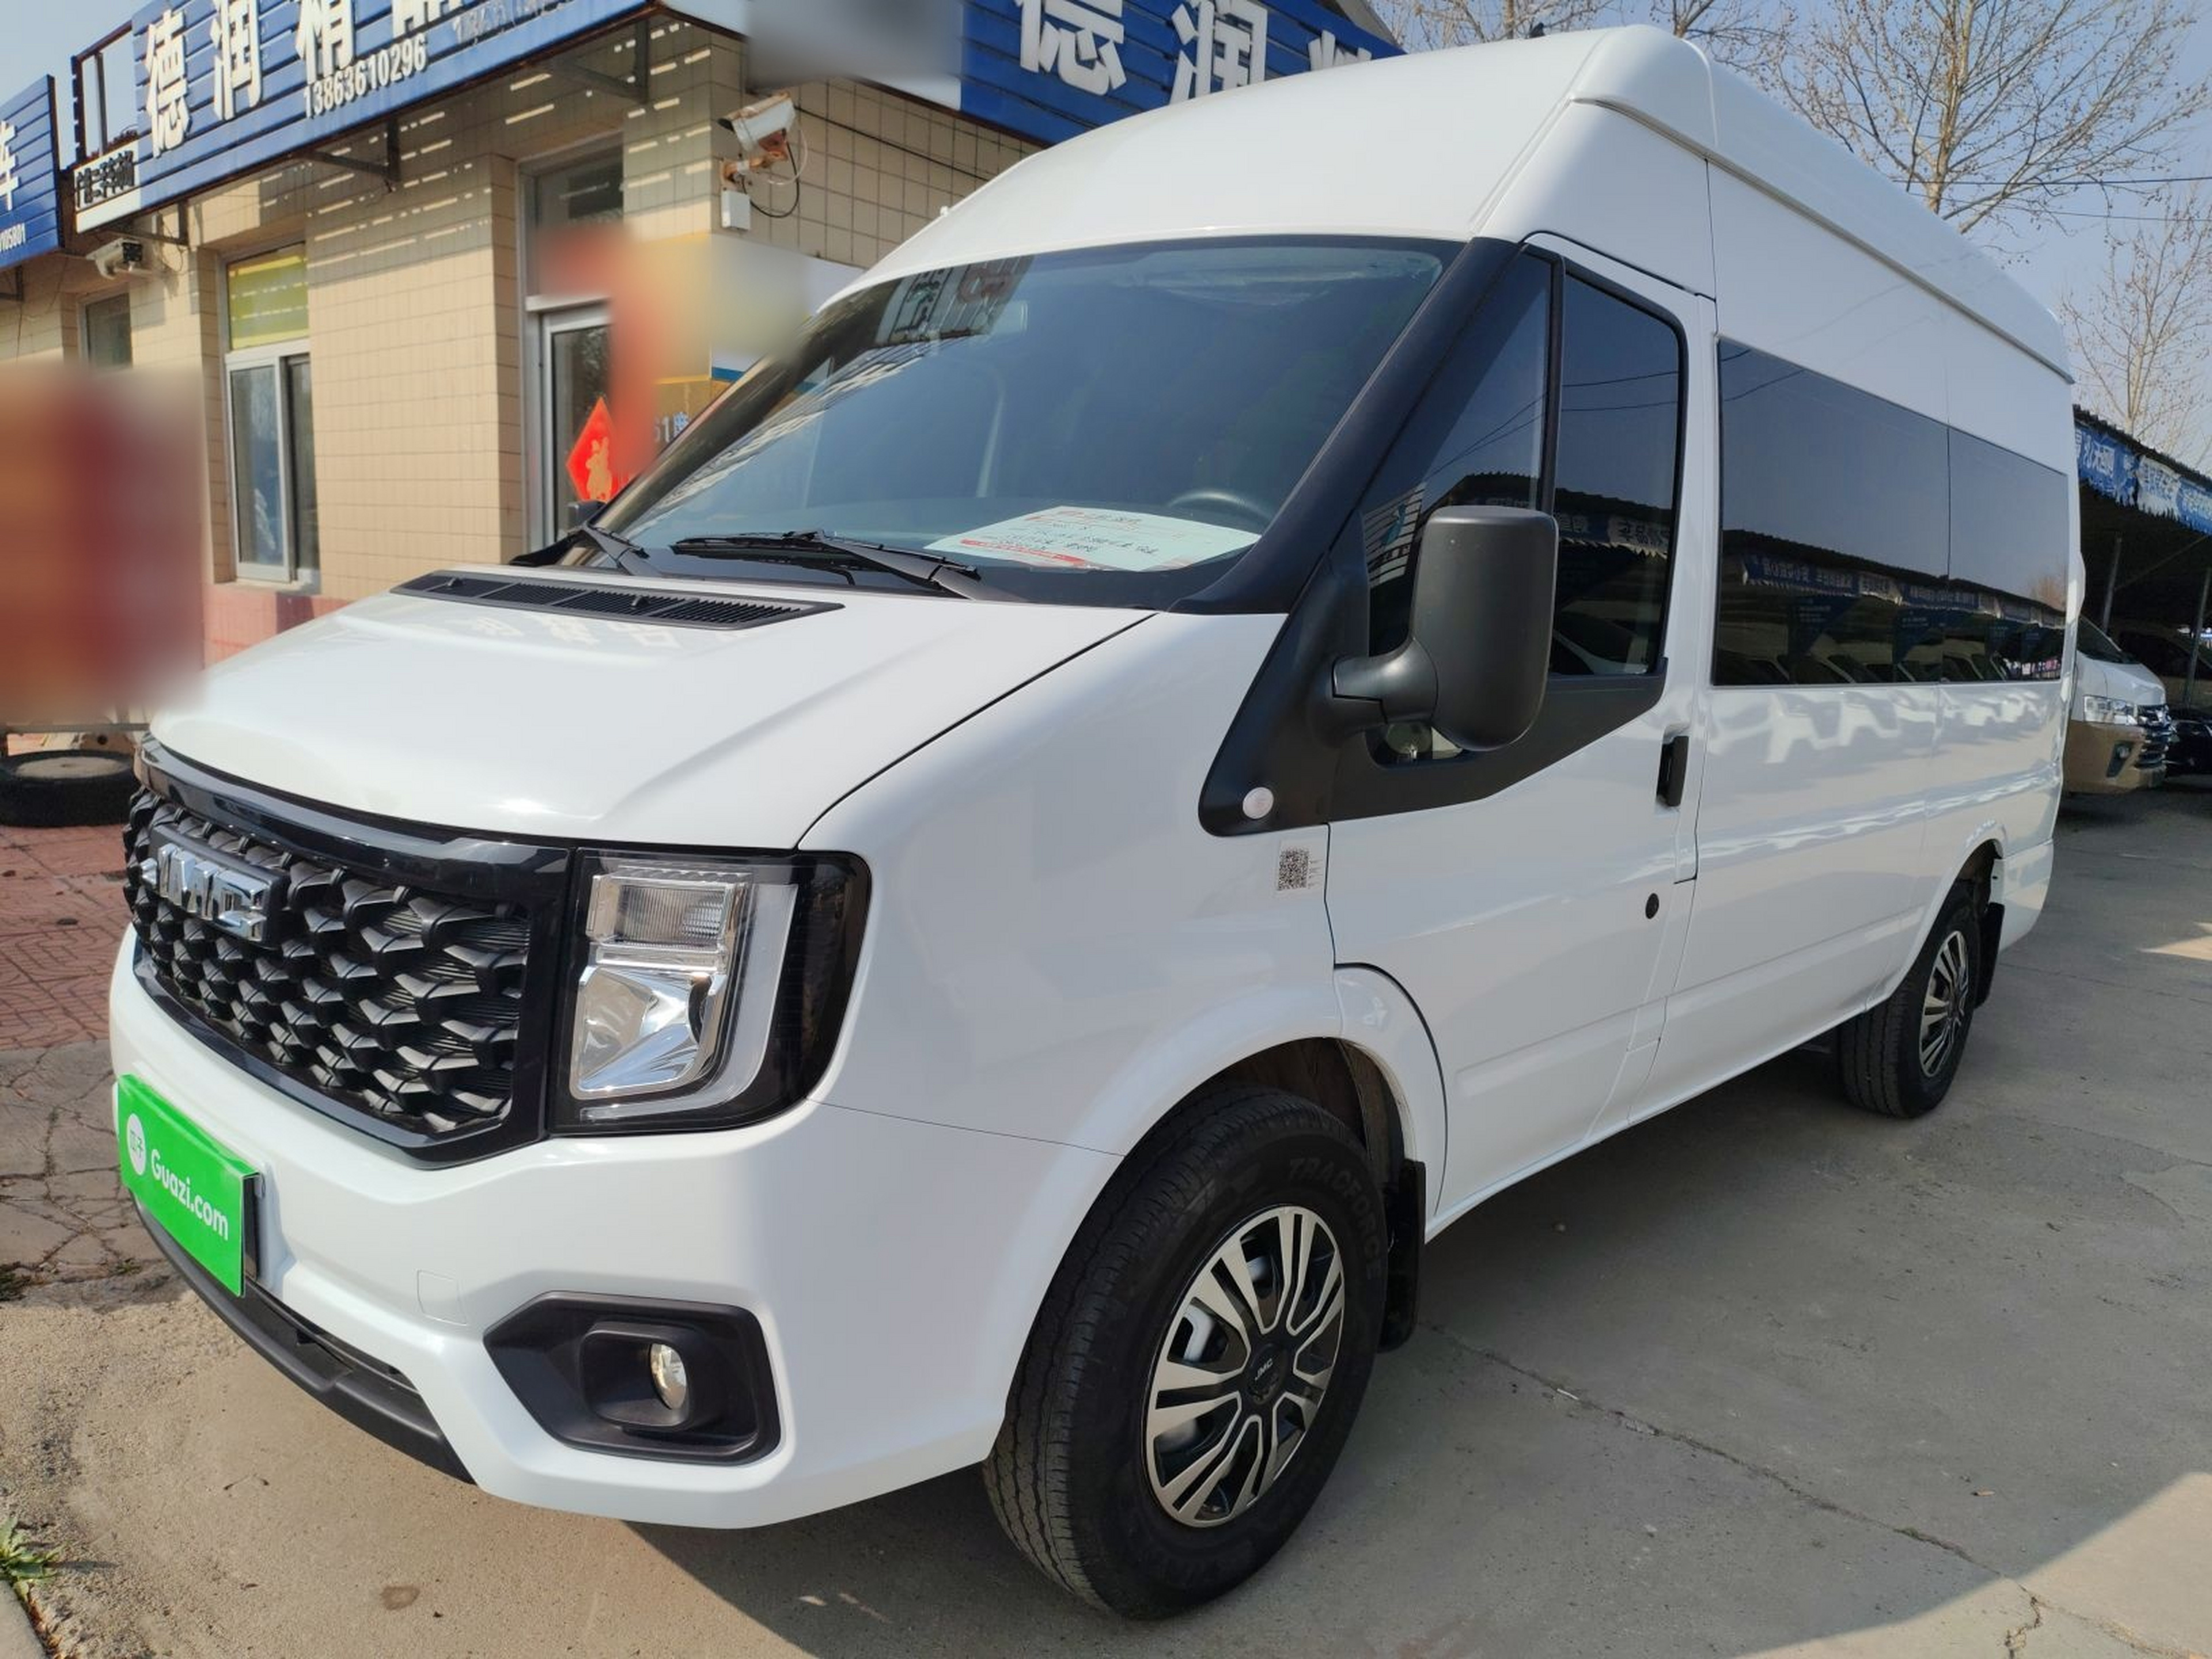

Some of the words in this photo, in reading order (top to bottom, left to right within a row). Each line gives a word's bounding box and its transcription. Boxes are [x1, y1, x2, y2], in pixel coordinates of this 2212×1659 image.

[304, 32, 428, 119] 13863610296
[151, 1149, 228, 1241] Guazi.com
[1254, 1357, 1274, 1381] JMC
